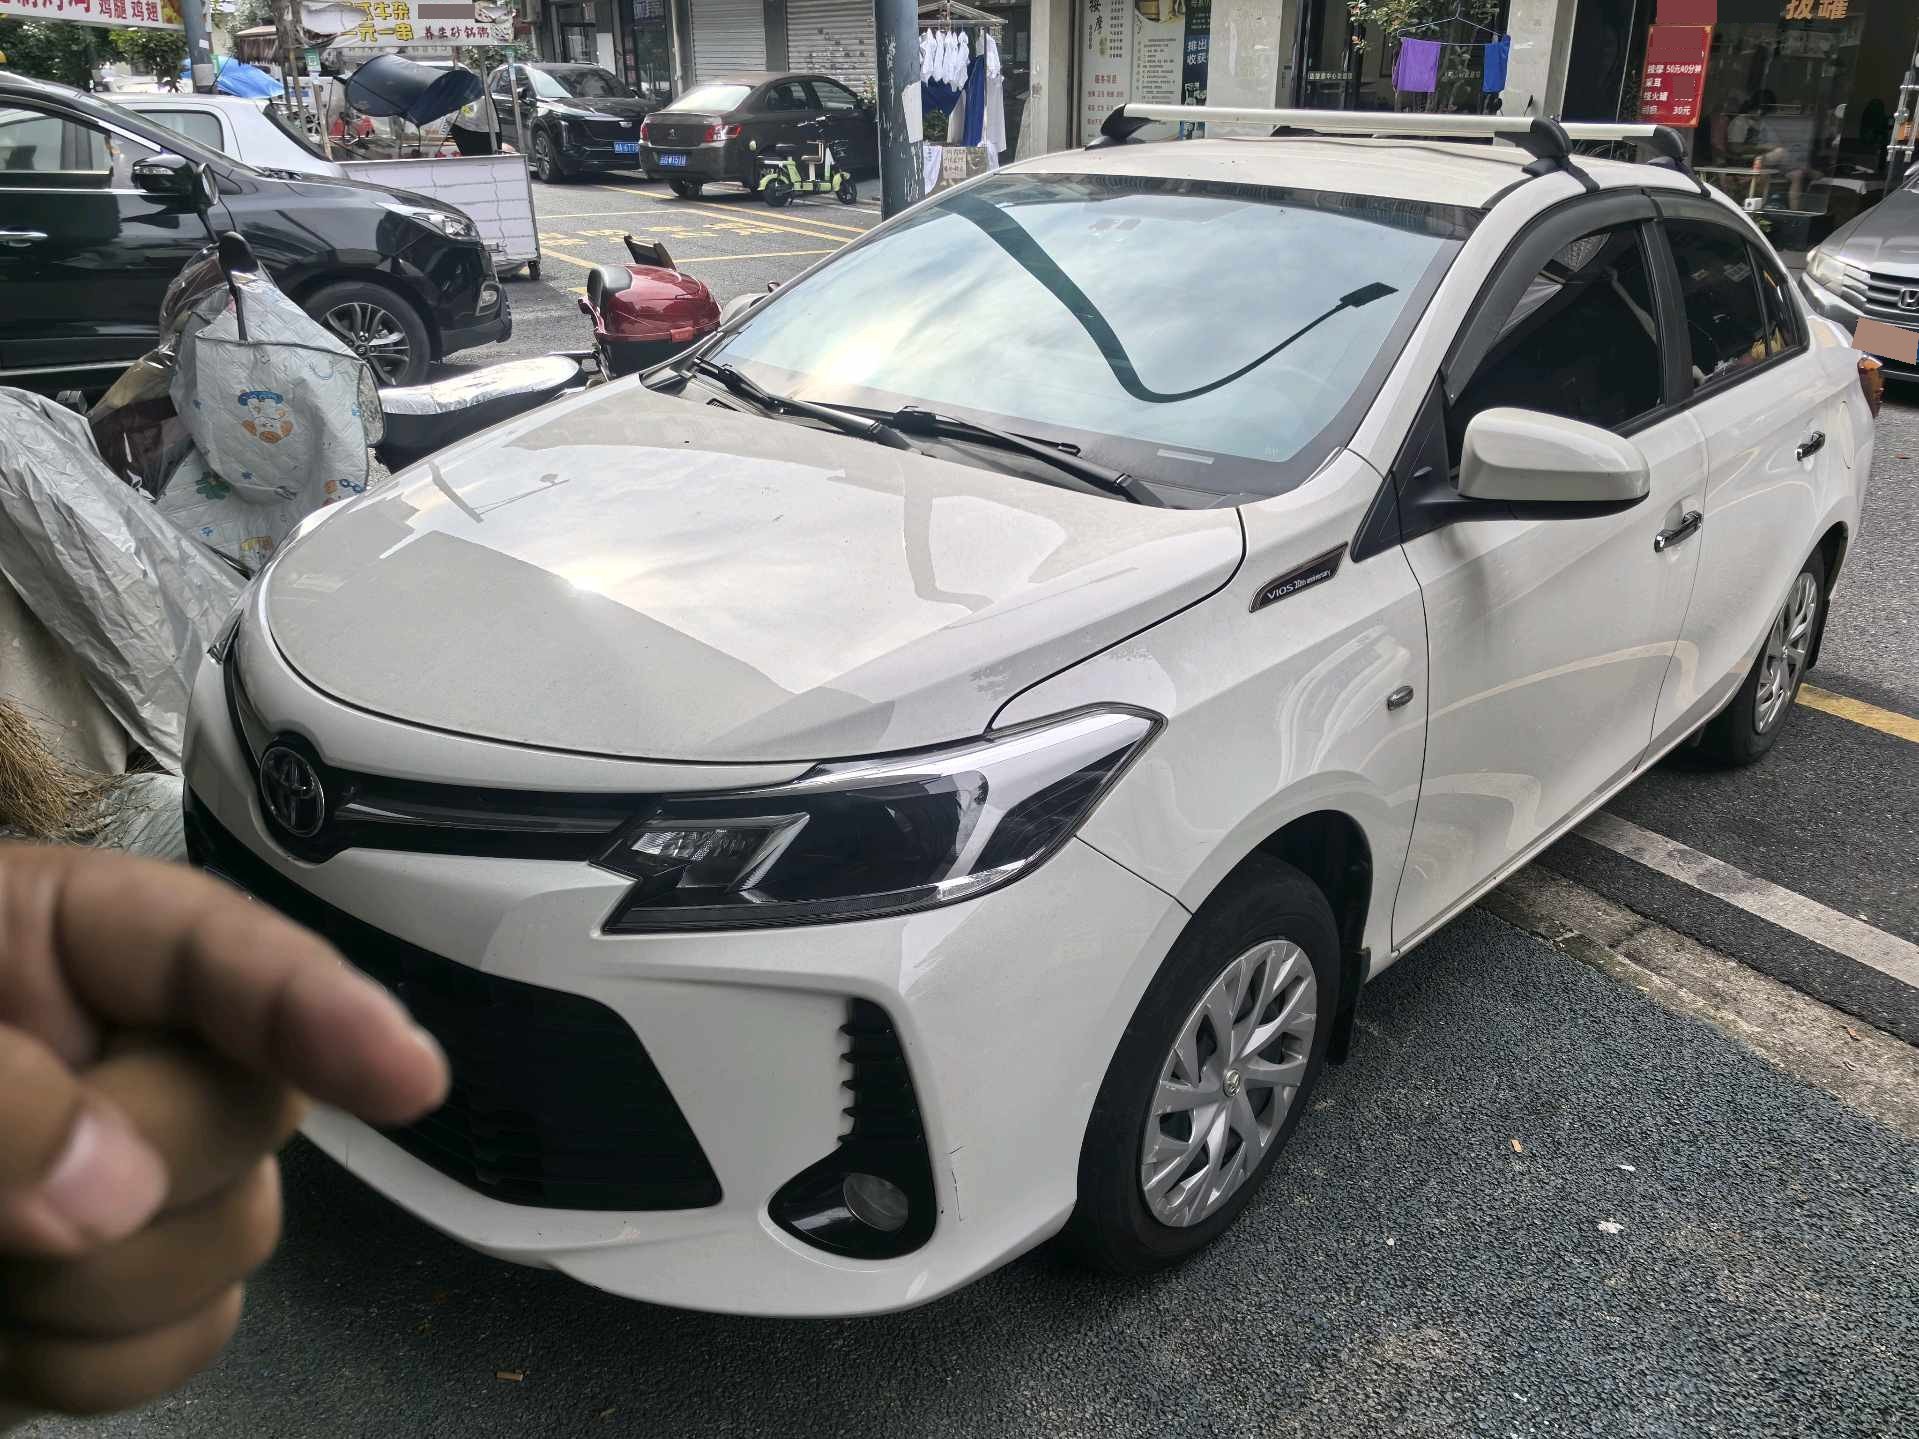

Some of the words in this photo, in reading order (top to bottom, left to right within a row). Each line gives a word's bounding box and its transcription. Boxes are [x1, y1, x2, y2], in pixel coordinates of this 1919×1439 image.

[100, 1, 127, 19] 鸡腿
[131, 2, 159, 21] 鸡翅
[424, 26, 491, 40] 养生砂锅粥
[1672, 105, 1692, 116] 30元
[1267, 583, 1294, 599] VIOS
